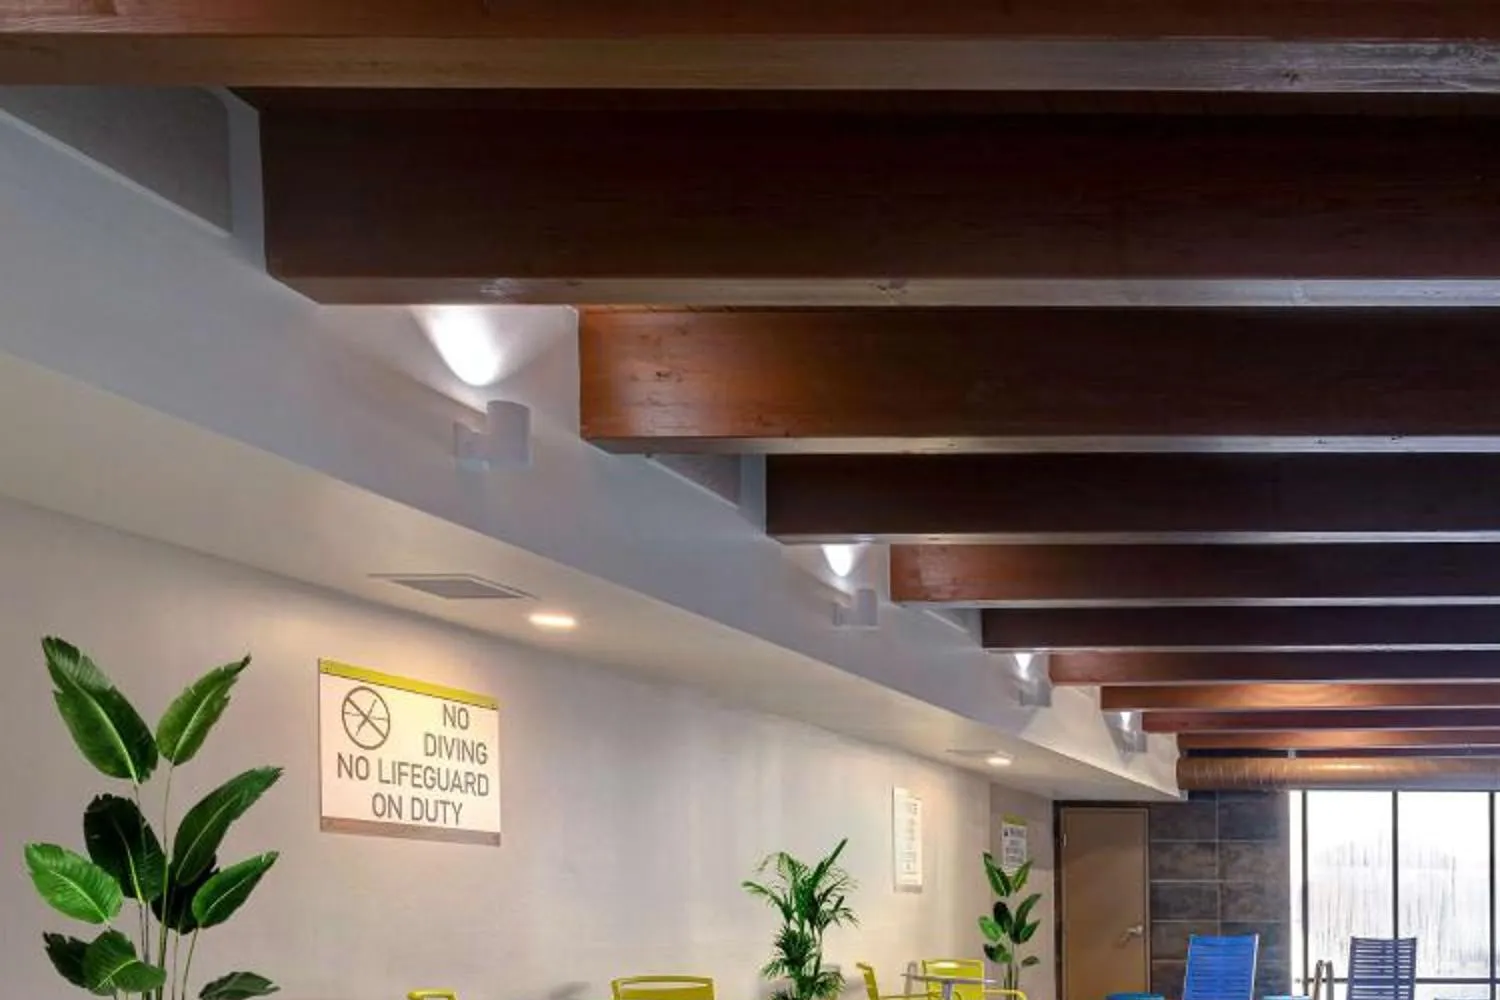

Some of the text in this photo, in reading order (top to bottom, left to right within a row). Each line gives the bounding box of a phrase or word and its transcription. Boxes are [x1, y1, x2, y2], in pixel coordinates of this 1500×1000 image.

[443, 703, 470, 731] NO
[424, 732, 489, 766] DIVING
[337, 752, 489, 798] NO LIFEGUARD
[372, 792, 464, 826] ON DUTY
